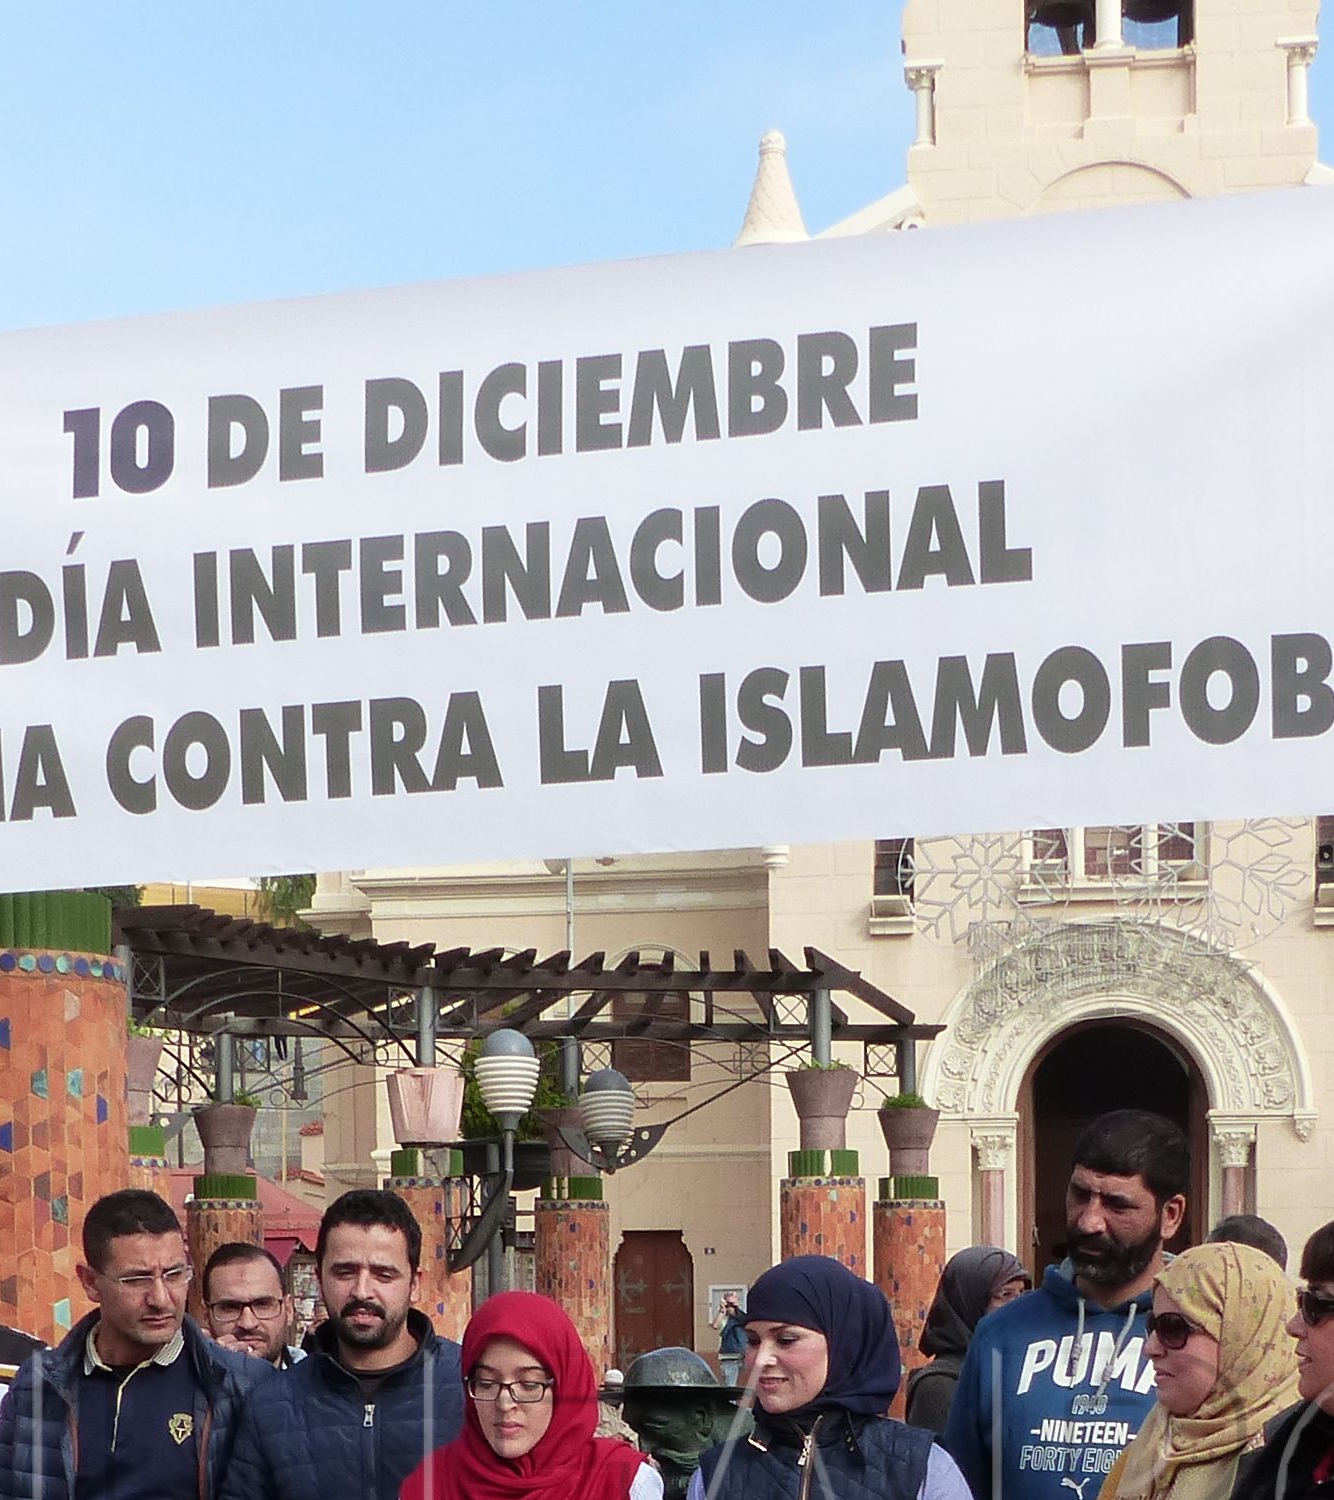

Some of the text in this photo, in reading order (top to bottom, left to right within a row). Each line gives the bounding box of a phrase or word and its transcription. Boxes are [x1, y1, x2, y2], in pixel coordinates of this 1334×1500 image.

[63, 322, 918, 499] 10 DE DICIEMBRE
[194, 480, 1033, 648] INTERNACIONAL
[106, 691, 504, 815] CONTRA
[538, 679, 664, 785] LA
[1019, 1445, 1083, 1471] FORTY
